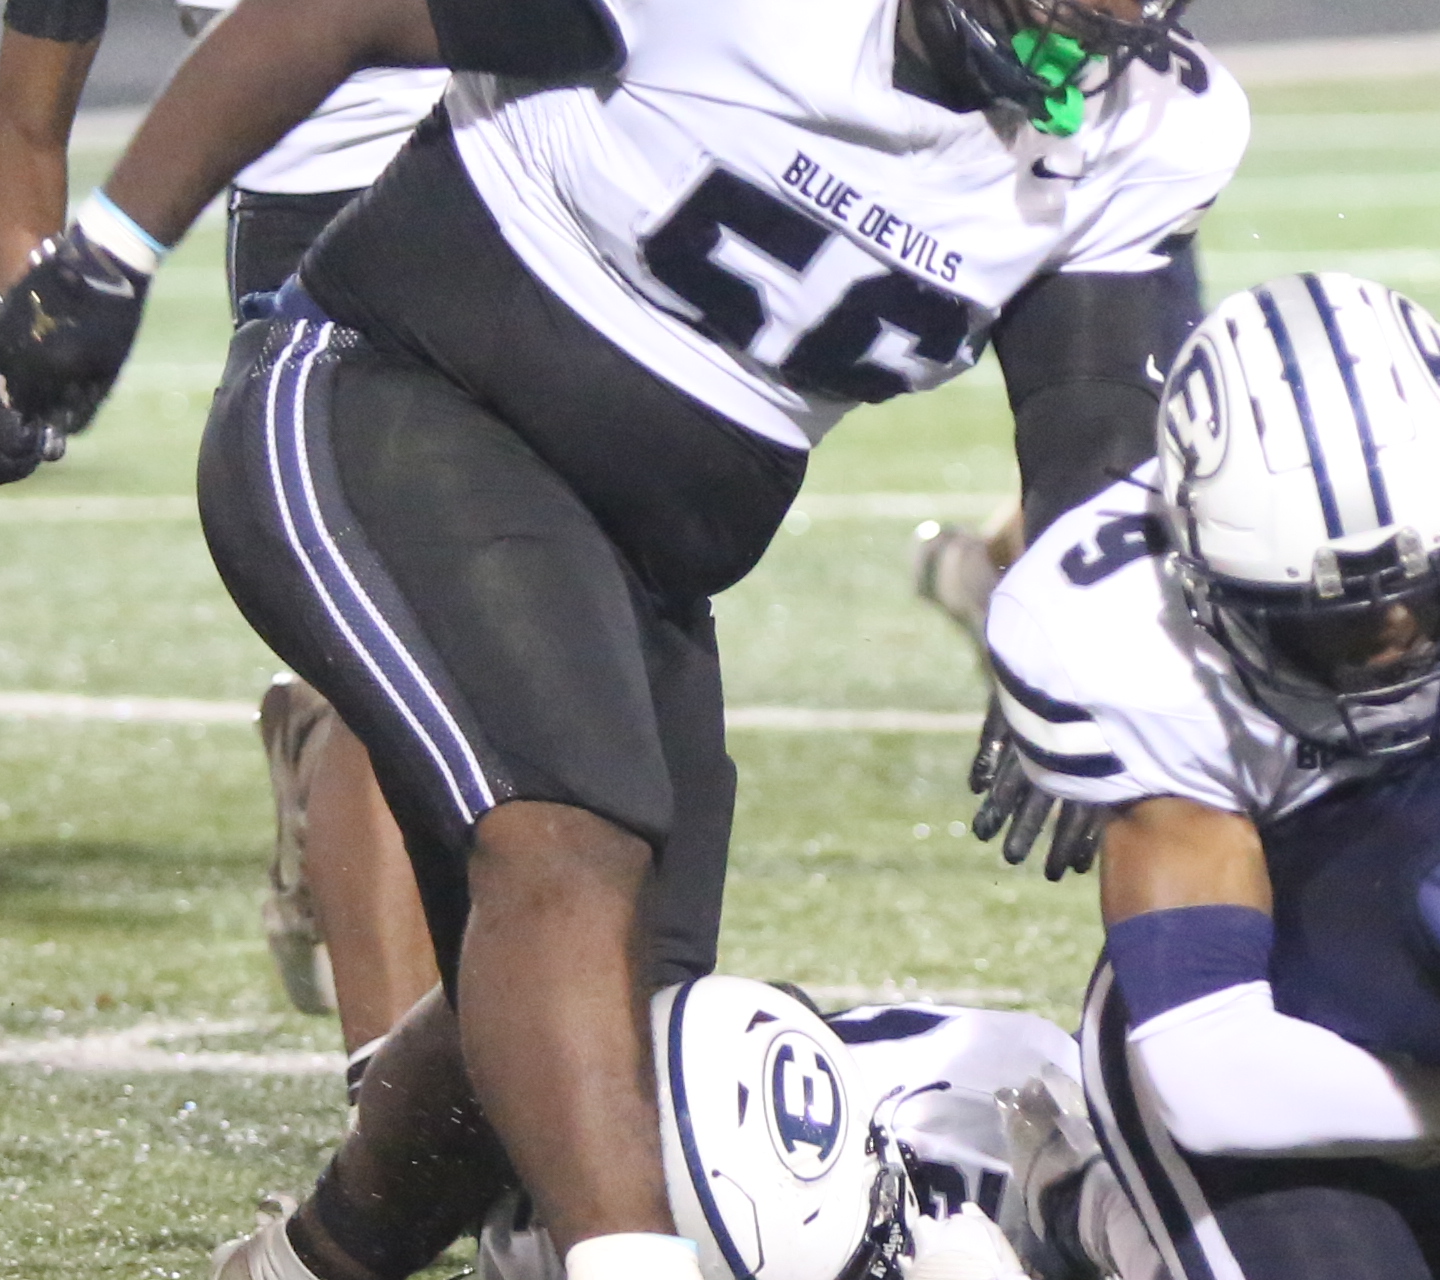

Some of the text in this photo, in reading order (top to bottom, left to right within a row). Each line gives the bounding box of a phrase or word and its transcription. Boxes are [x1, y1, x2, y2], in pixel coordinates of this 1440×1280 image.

[781, 150, 963, 283] BLUE DEVILS
[641, 164, 972, 405] 56
[772, 1043, 842, 1163] E
